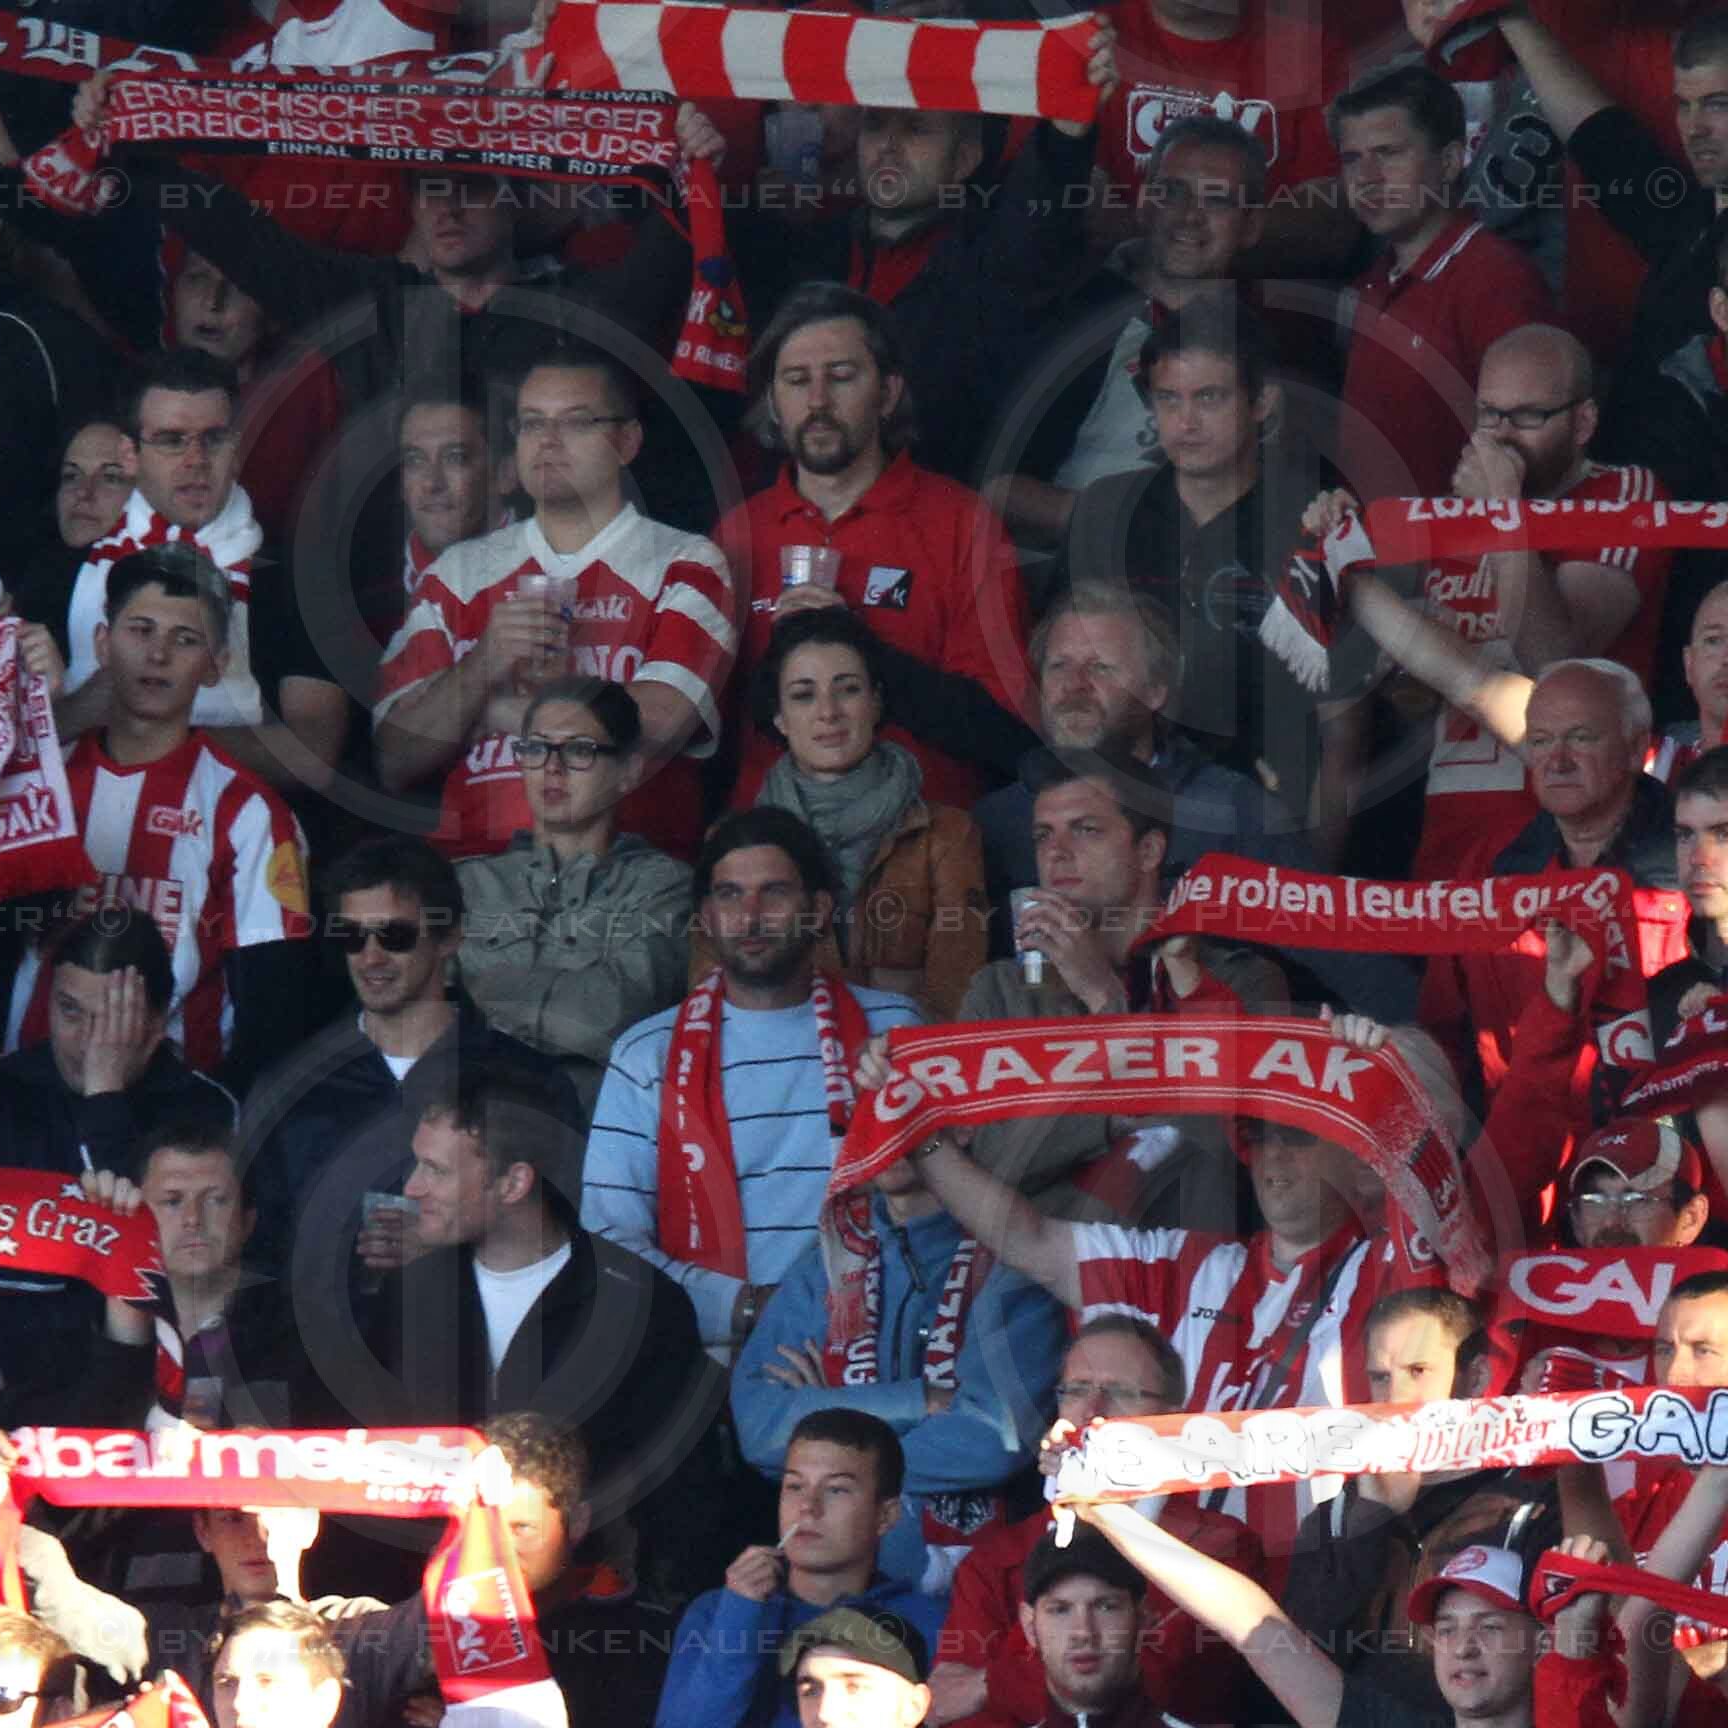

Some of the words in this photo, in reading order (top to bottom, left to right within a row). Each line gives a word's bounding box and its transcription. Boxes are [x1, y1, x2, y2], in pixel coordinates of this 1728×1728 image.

[442, 99, 665, 136] CUPSIEGER
[267, 141, 352, 158] EINMAL
[147, 804, 204, 837] GAK
[1223, 866, 1335, 917] roten
[873, 1036, 1221, 1122] GRAZER
[1248, 1039, 1376, 1102] AK
[24, 1197, 121, 1258] Graz
